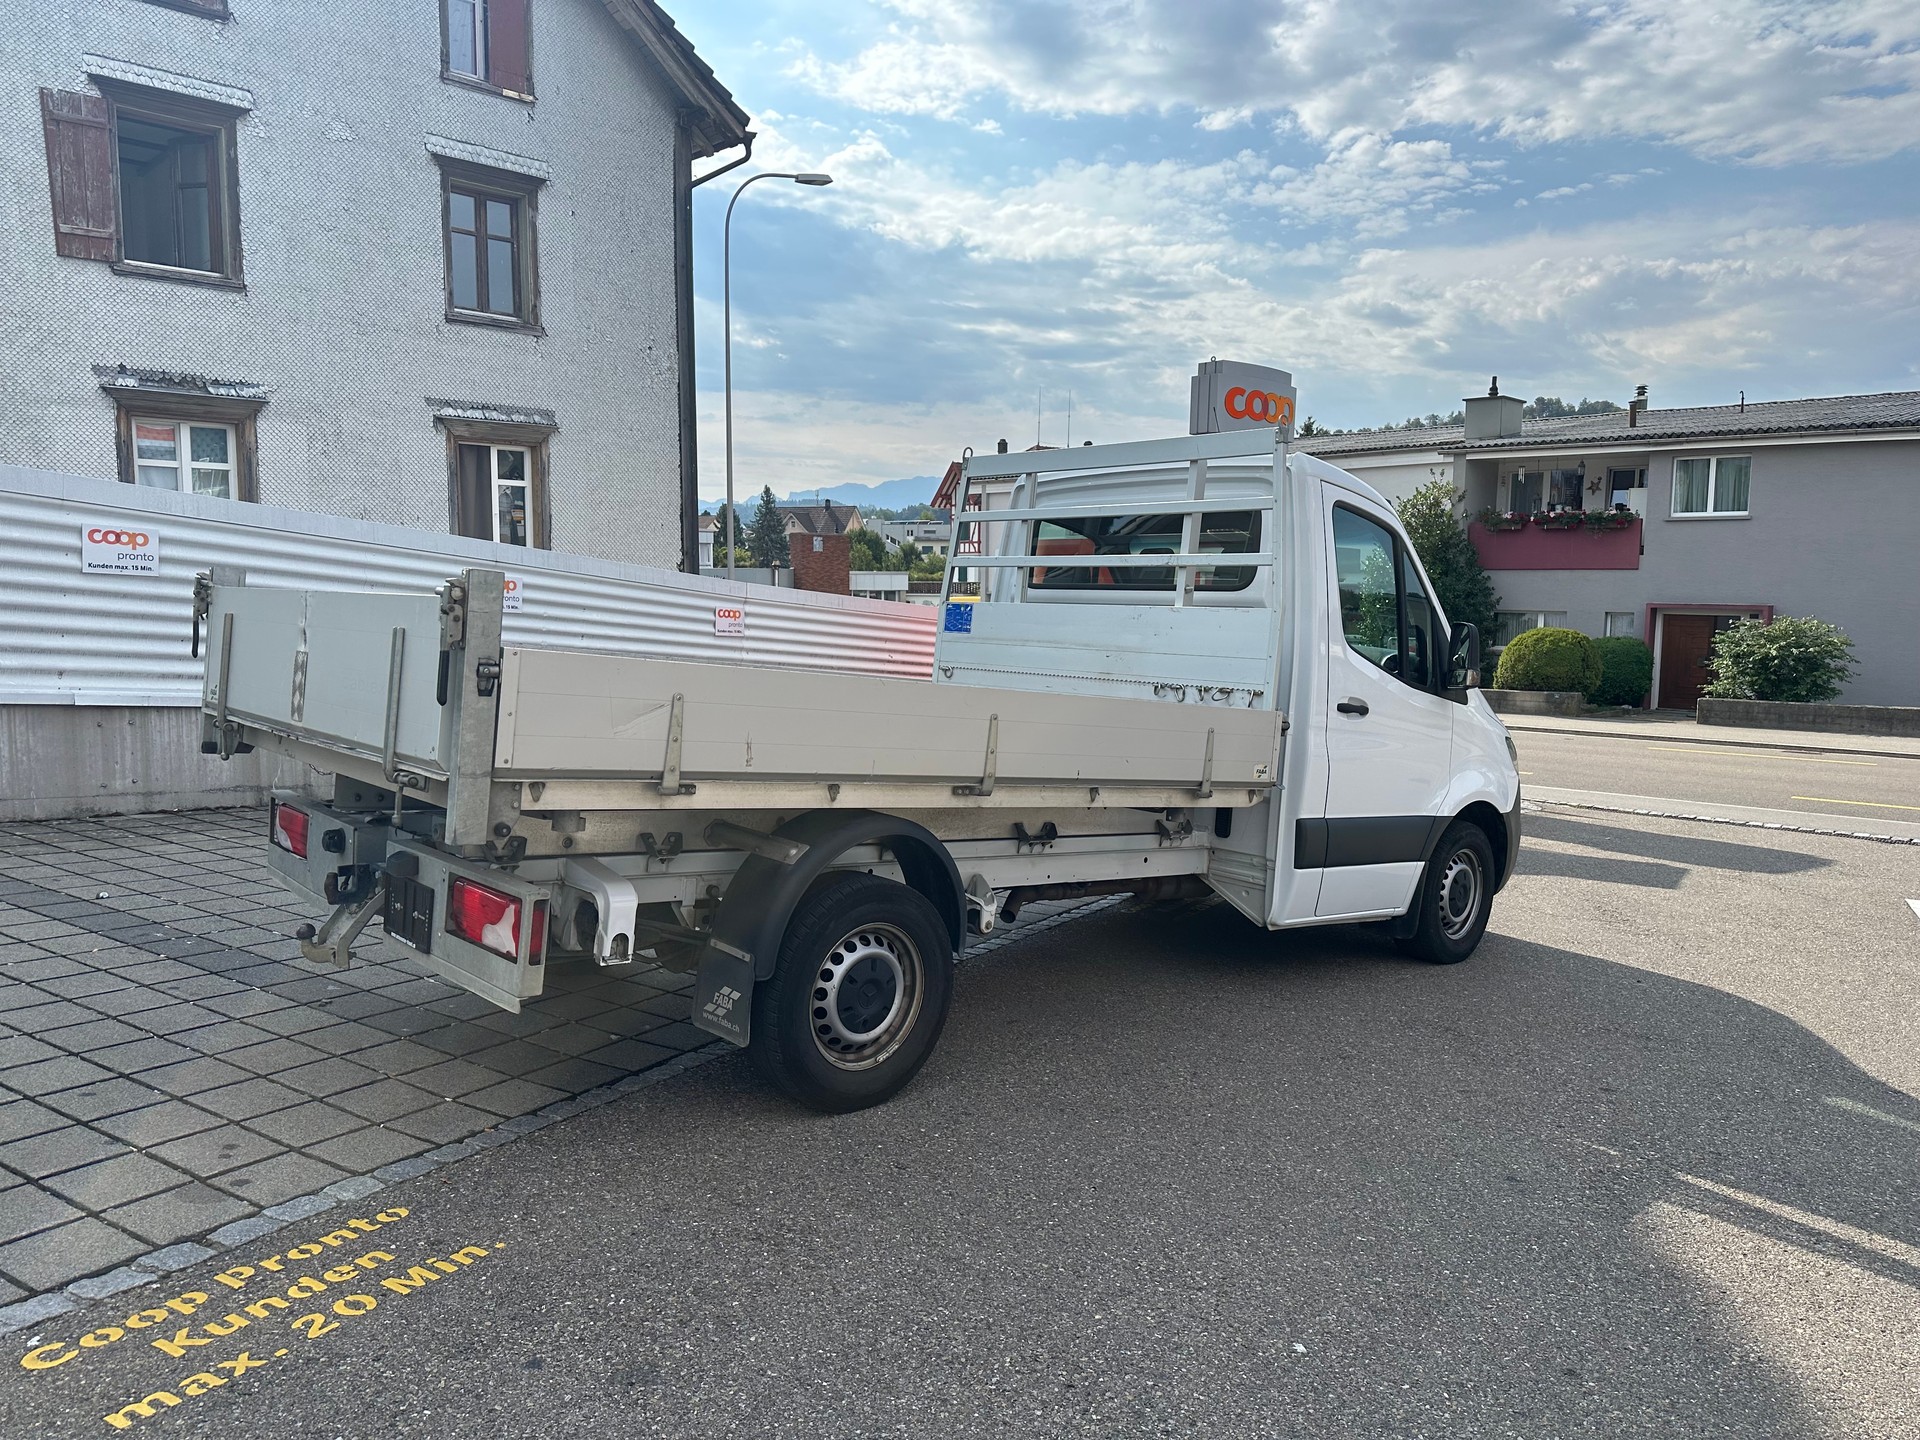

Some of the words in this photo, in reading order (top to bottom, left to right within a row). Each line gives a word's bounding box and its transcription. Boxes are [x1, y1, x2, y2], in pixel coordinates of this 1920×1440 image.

[1224, 386, 1294, 424] coop
[87, 528, 149, 550] coop
[117, 552, 154, 561] pronto
[717, 609, 741, 621] coop
[713, 991, 734, 1011] FABA
[702, 1011, 740, 1033] www.faba.ch
[20, 1291, 209, 1370] Coop
[213, 1207, 410, 1289] pronto
[151, 1250, 396, 1358] Kunden
[103, 1346, 289, 1429] max.
[291, 1294, 377, 1339] 20
[380, 1242, 506, 1295] Min.
